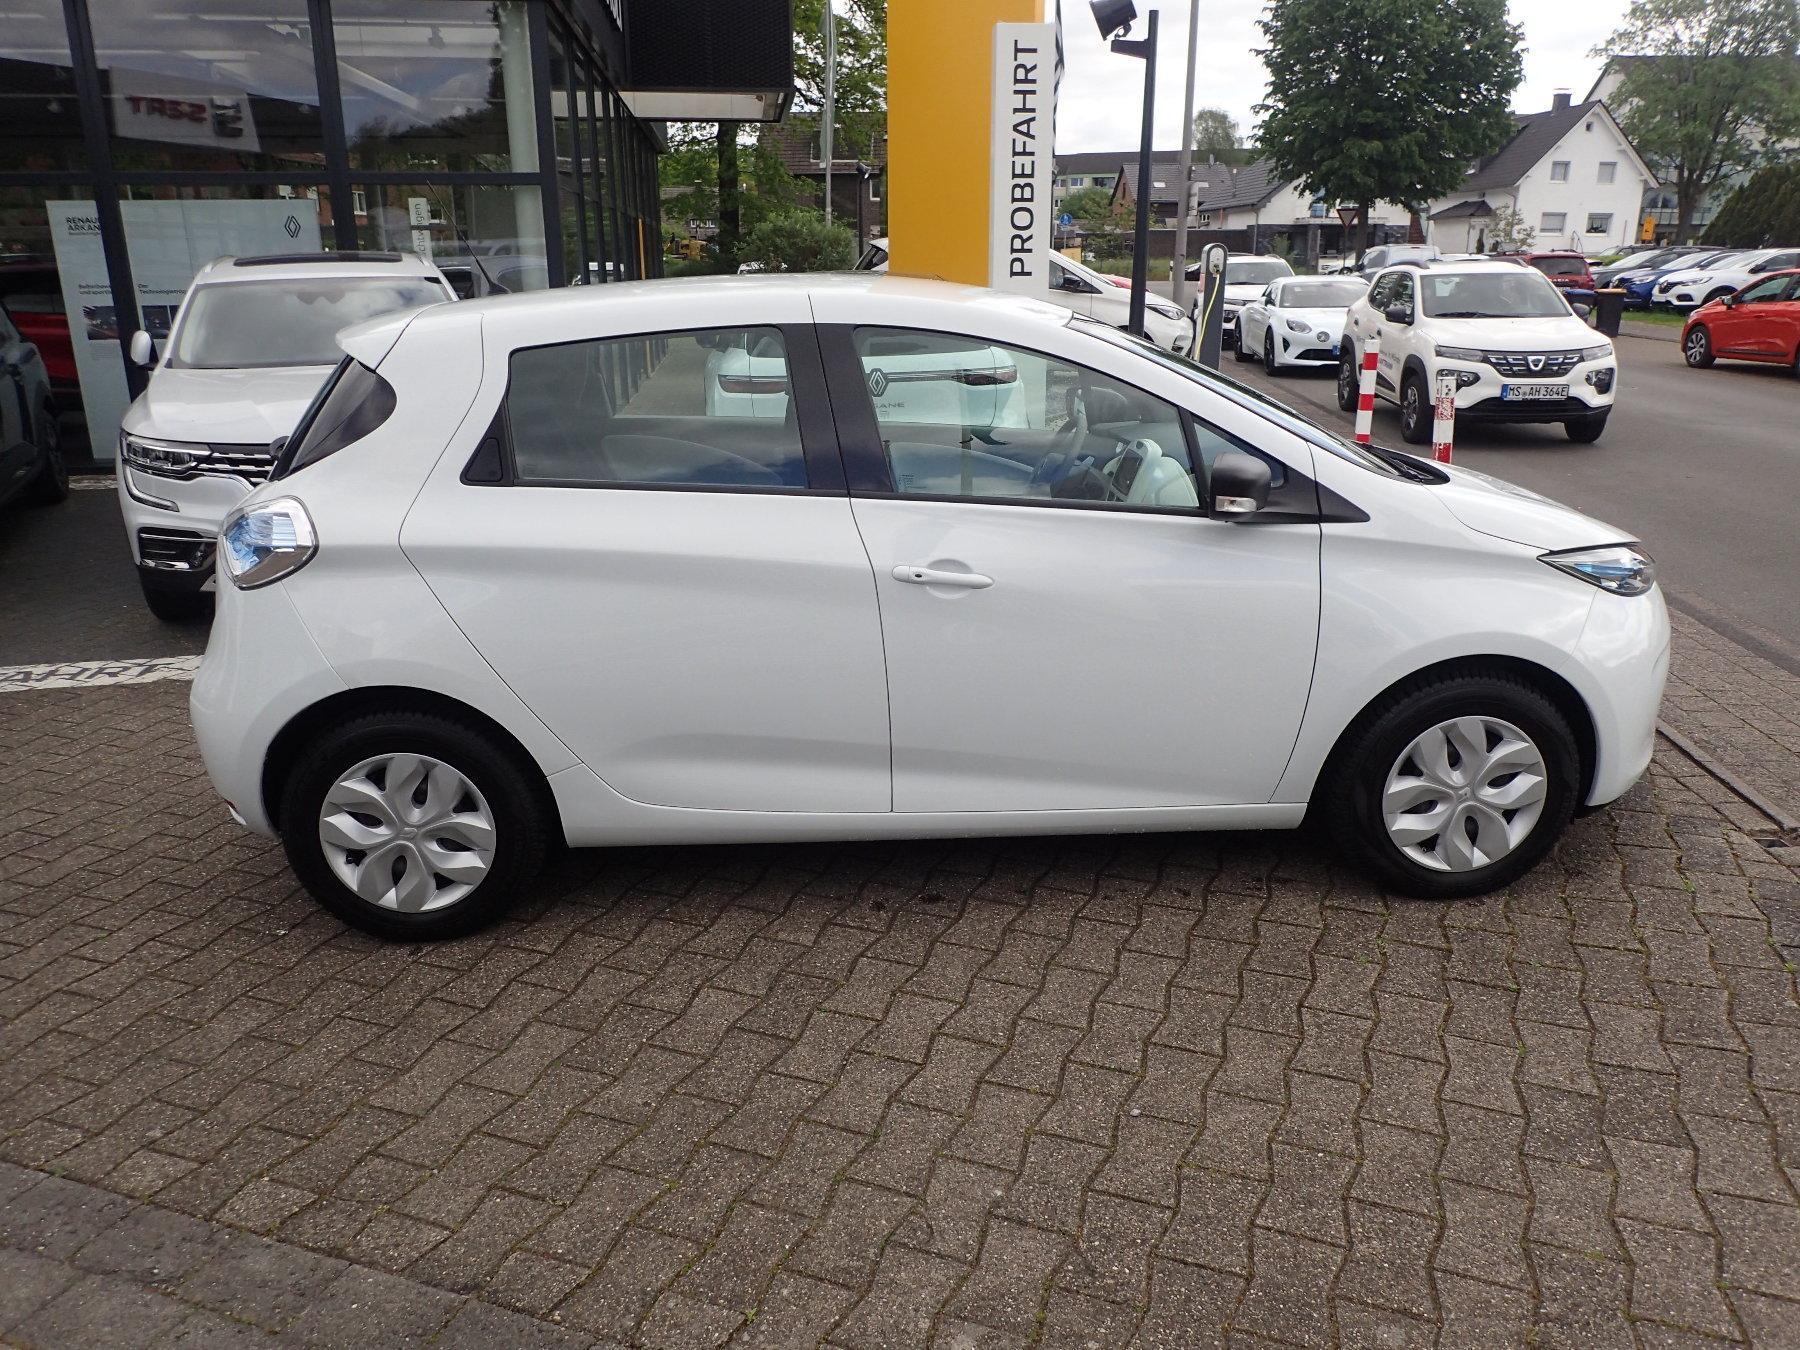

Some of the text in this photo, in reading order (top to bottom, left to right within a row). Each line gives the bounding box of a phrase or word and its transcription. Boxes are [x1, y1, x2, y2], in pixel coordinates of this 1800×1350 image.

[1009, 38, 1038, 279] PROBEFAHRT
[1508, 386, 1568, 397] MS AH 364E
